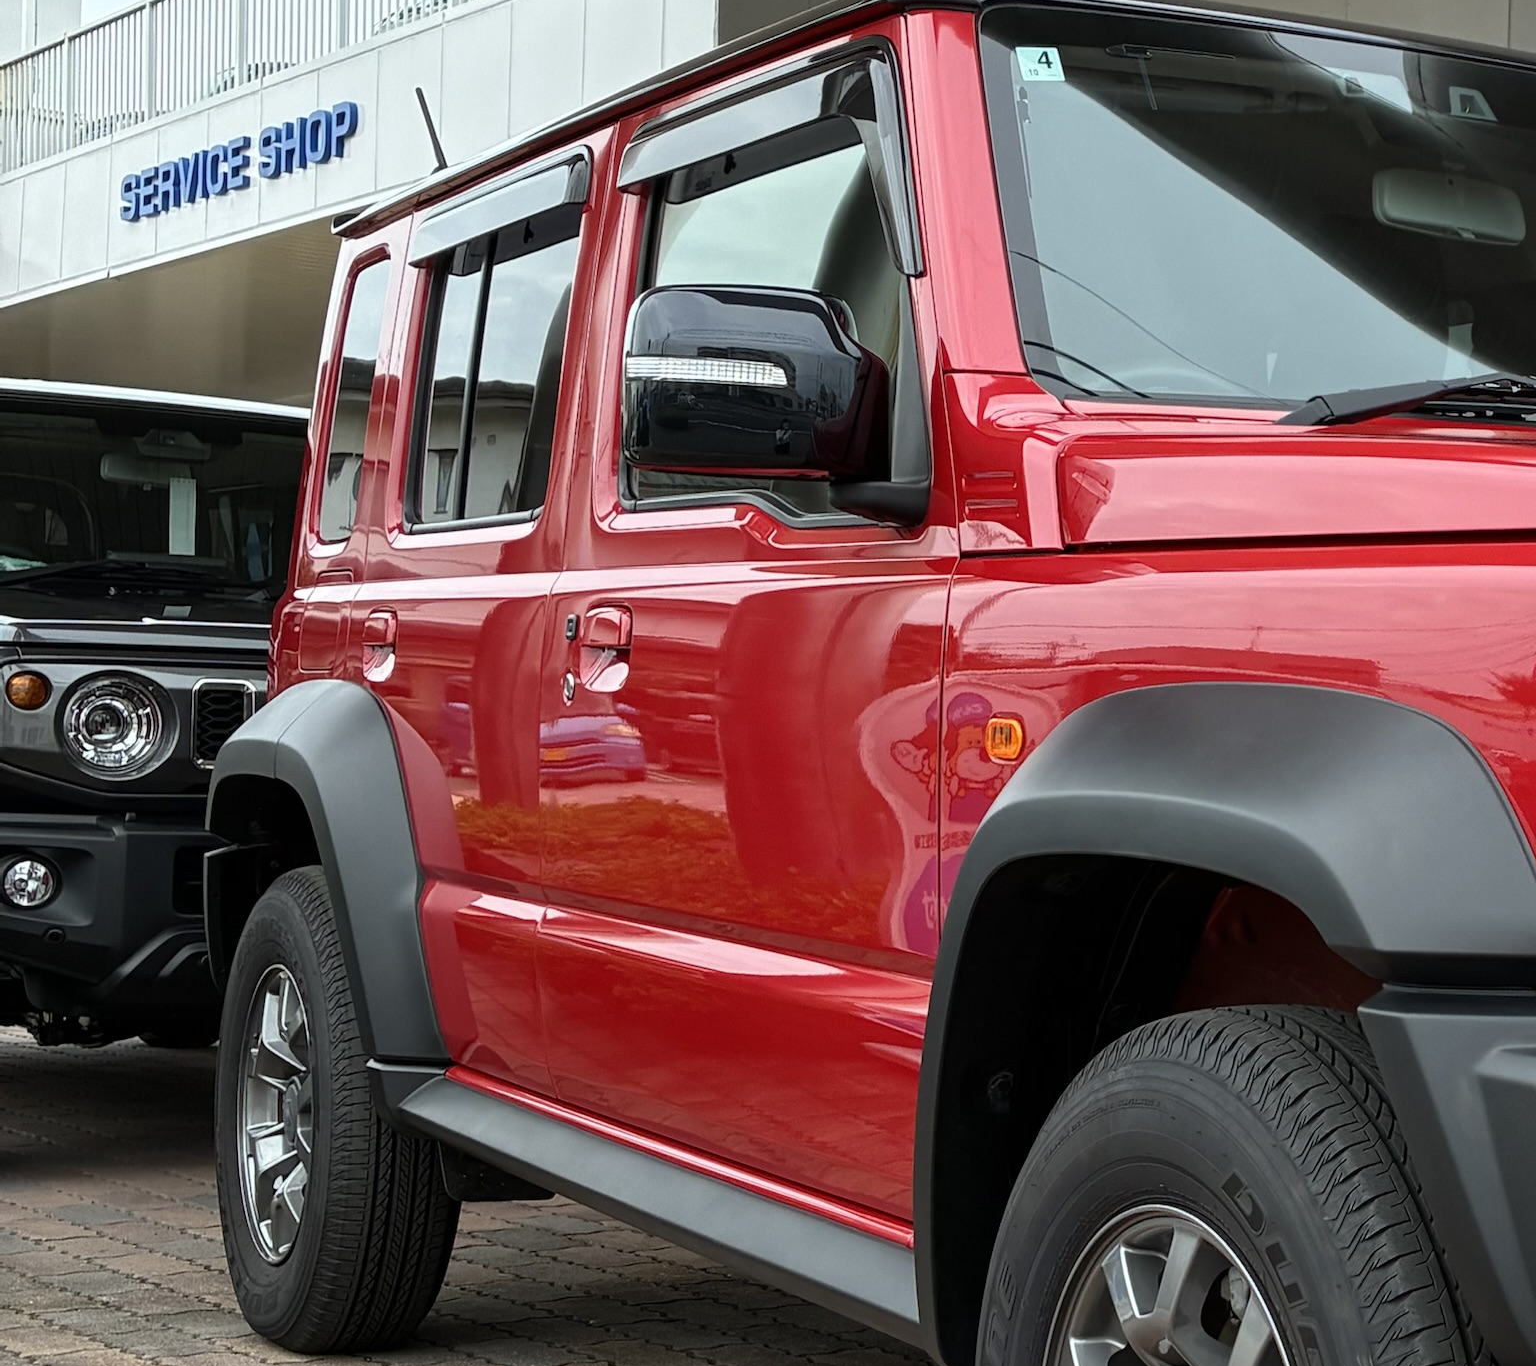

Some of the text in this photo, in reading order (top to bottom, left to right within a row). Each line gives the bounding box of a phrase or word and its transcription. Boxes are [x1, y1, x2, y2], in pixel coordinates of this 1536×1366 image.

[1037, 51, 1053, 69] 4
[120, 101, 358, 222] SERVICE SHOP
